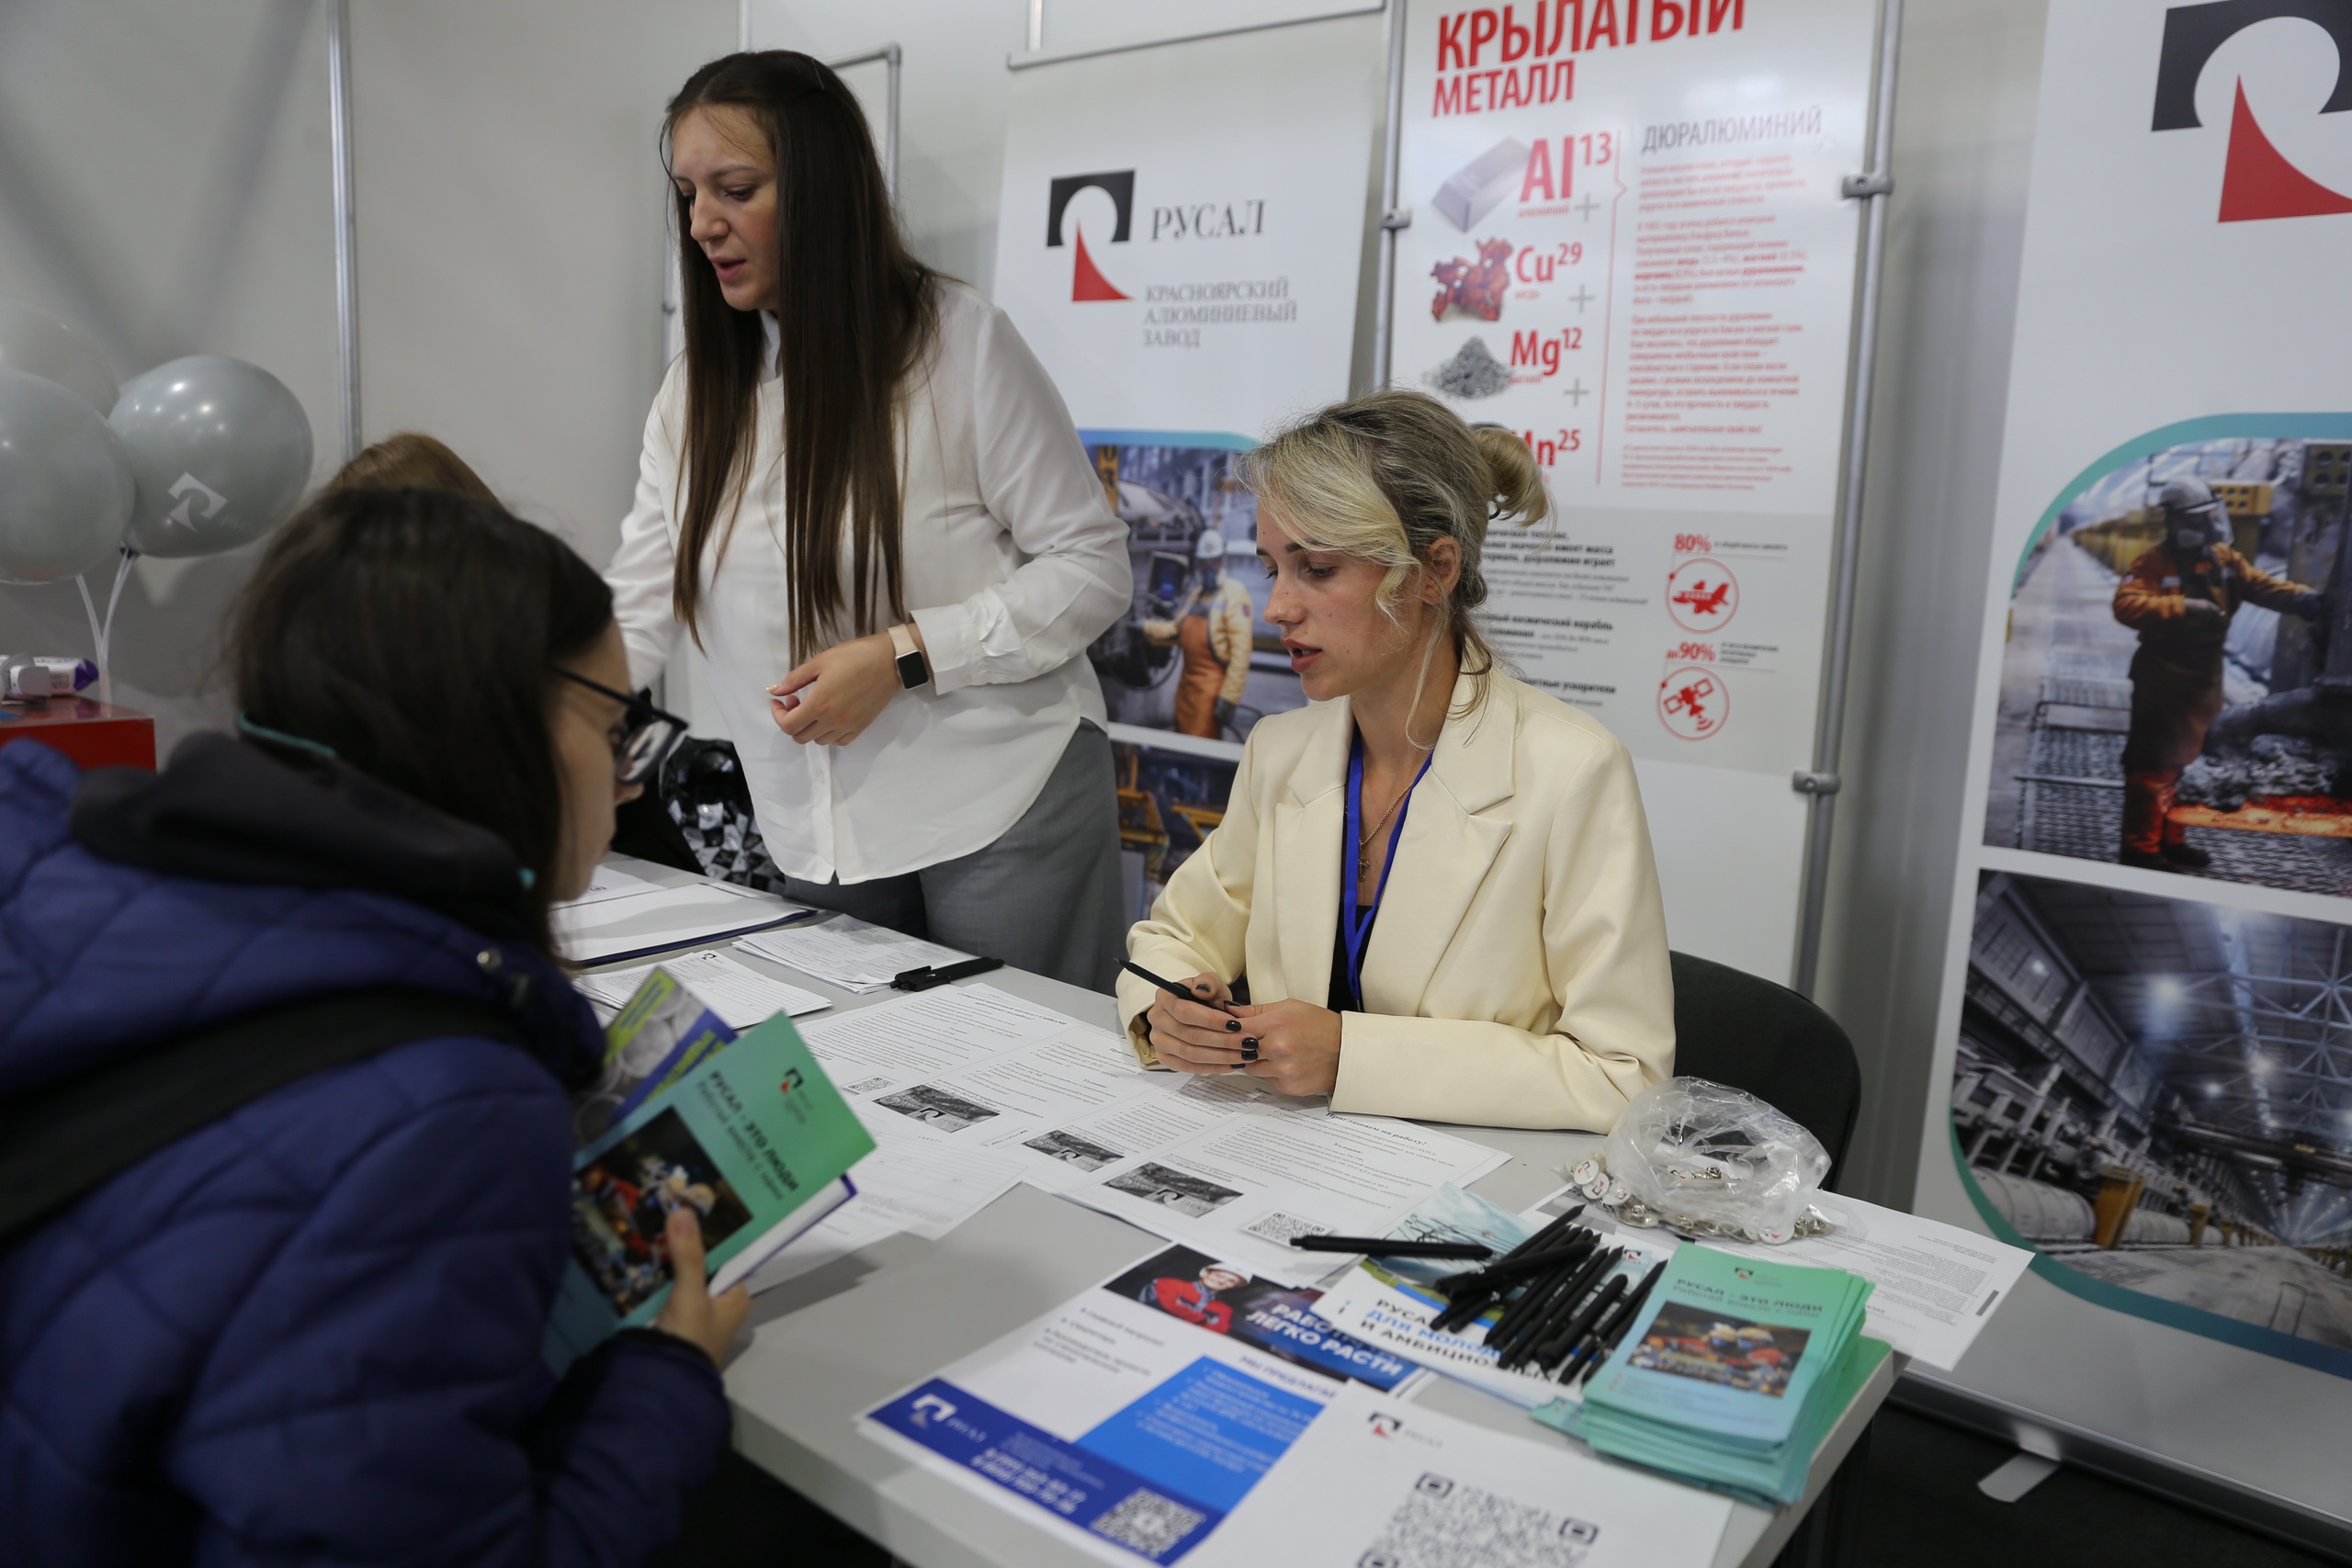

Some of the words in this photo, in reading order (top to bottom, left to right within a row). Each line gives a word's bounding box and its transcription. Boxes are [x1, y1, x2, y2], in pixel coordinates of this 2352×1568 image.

[1431, 58, 1576, 118] МЕТАЛЛ
[1641, 106, 1823, 155] ДЮРАЛЮМИНИЙ
[1151, 198, 1266, 241] РУСАЛ
[1146, 276, 1289, 301] КРАСНОЯРСКИЙ
[1145, 299, 1297, 323] АЛЮМИНИЕВЫЙ
[1144, 330, 1201, 347] ЗАВОД
[1674, 534, 1711, 553] 80%
[1574, 618, 1613, 631] корабль
[1679, 641, 1716, 662] 90%
[1326, 1112, 1380, 1133] Приглашаем
[1392, 1134, 1428, 1146] работу!
[1677, 1278, 1724, 1296] РУСАЛ
[1739, 1294, 1769, 1305] ЭТО
[1365, 1309, 1413, 1334] ДЛЯ
[1376, 1297, 1428, 1325] РУСА
[1361, 1318, 1375, 1332] И
[1245, 1309, 1322, 1346] ЛЕГКО
[1320, 1338, 1404, 1377] РАСТИ
[1263, 1364, 1337, 1400] ПРЕДЛАГАЕ
